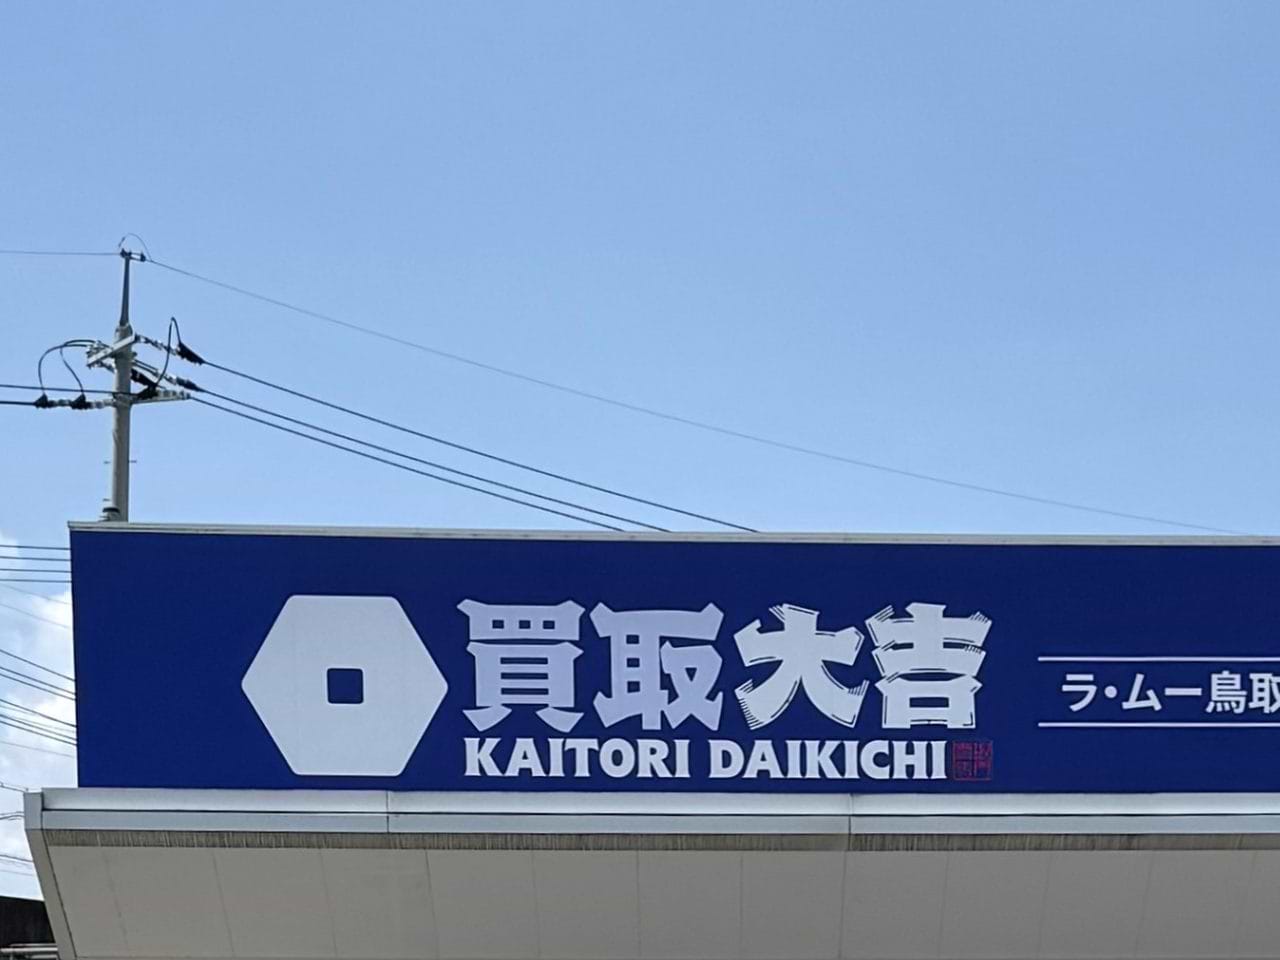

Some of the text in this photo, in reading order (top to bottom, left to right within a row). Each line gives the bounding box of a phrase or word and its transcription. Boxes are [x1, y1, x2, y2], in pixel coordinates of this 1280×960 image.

[457, 599, 994, 731] 買取大吉
[463, 738, 689, 779] KAITORI
[708, 740, 948, 780] DAIKICHI
